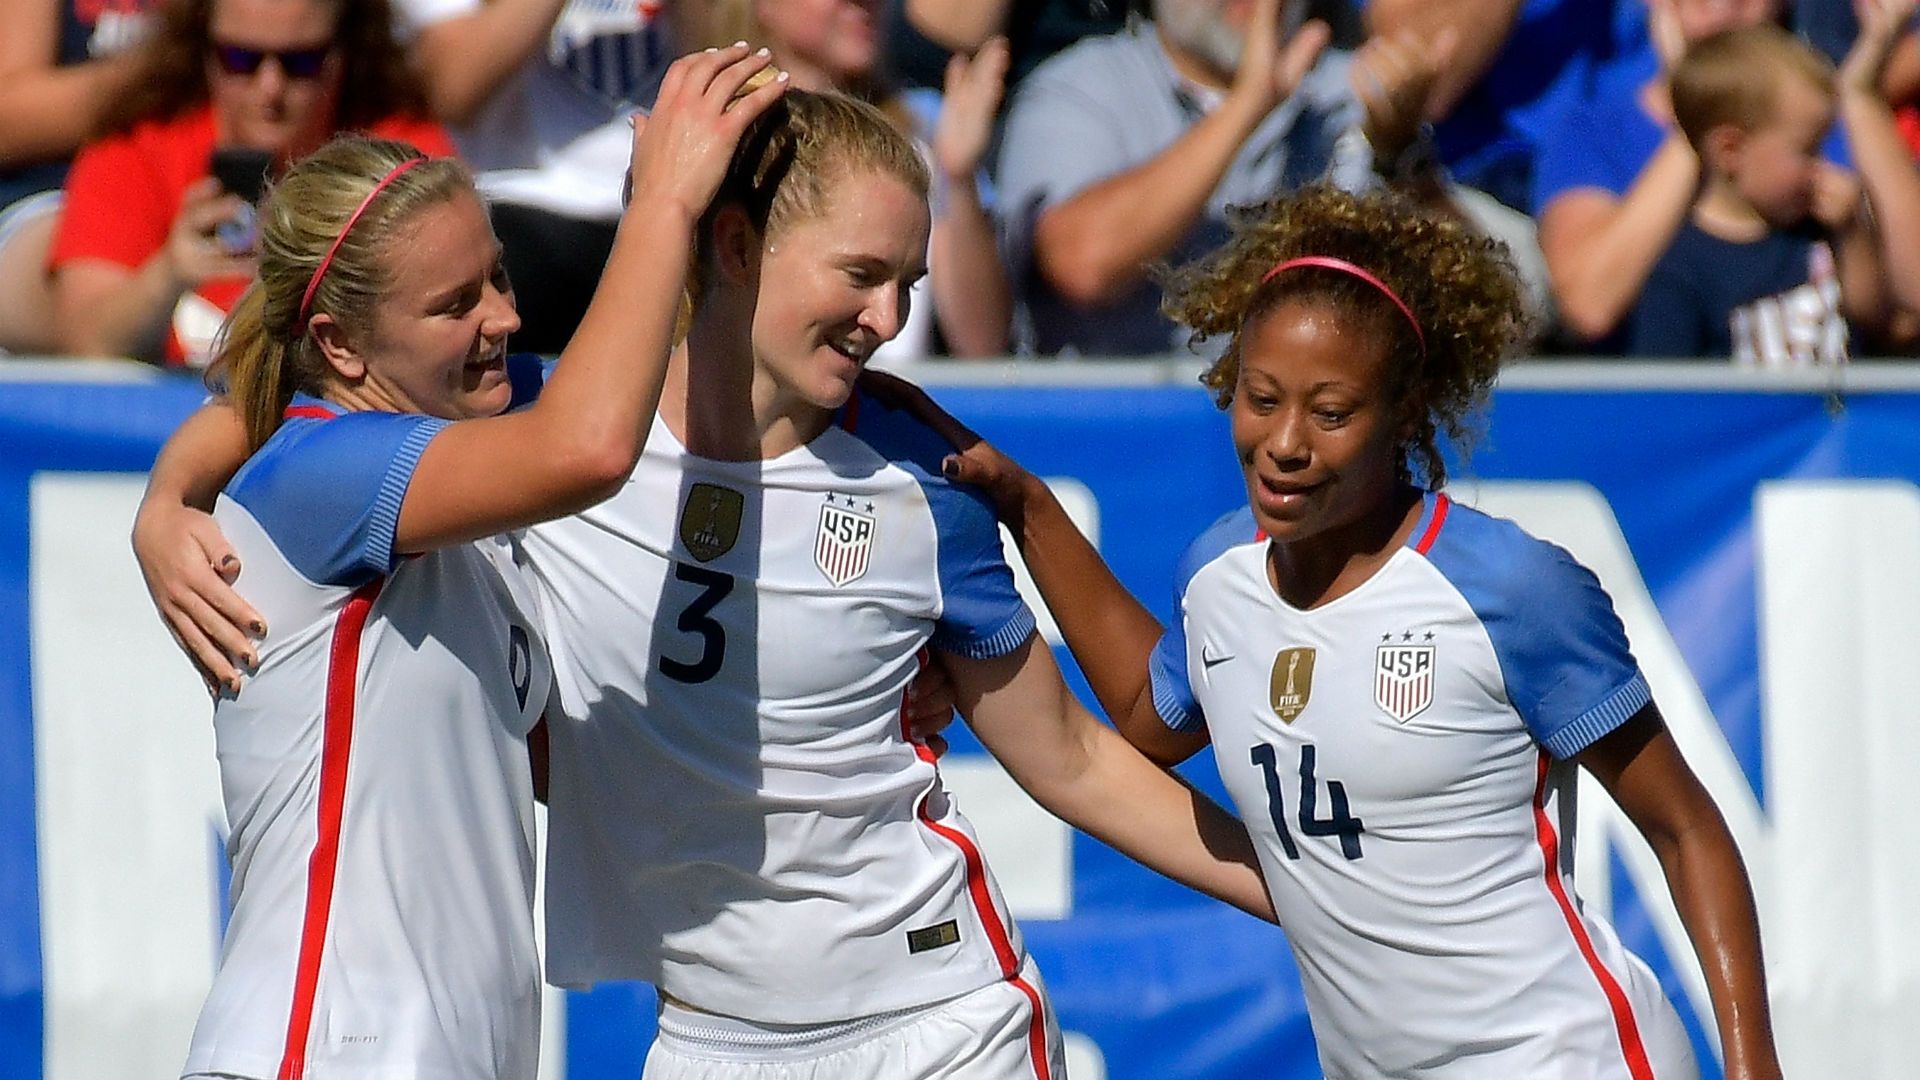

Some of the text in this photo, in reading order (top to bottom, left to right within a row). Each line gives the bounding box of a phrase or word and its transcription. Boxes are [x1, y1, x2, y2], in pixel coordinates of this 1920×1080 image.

[825, 510, 870, 543] USA
[659, 561, 734, 684] 3
[1381, 651, 1430, 678] USA
[1280, 695, 1300, 707] FIFA
[1250, 743, 1365, 860] 14
